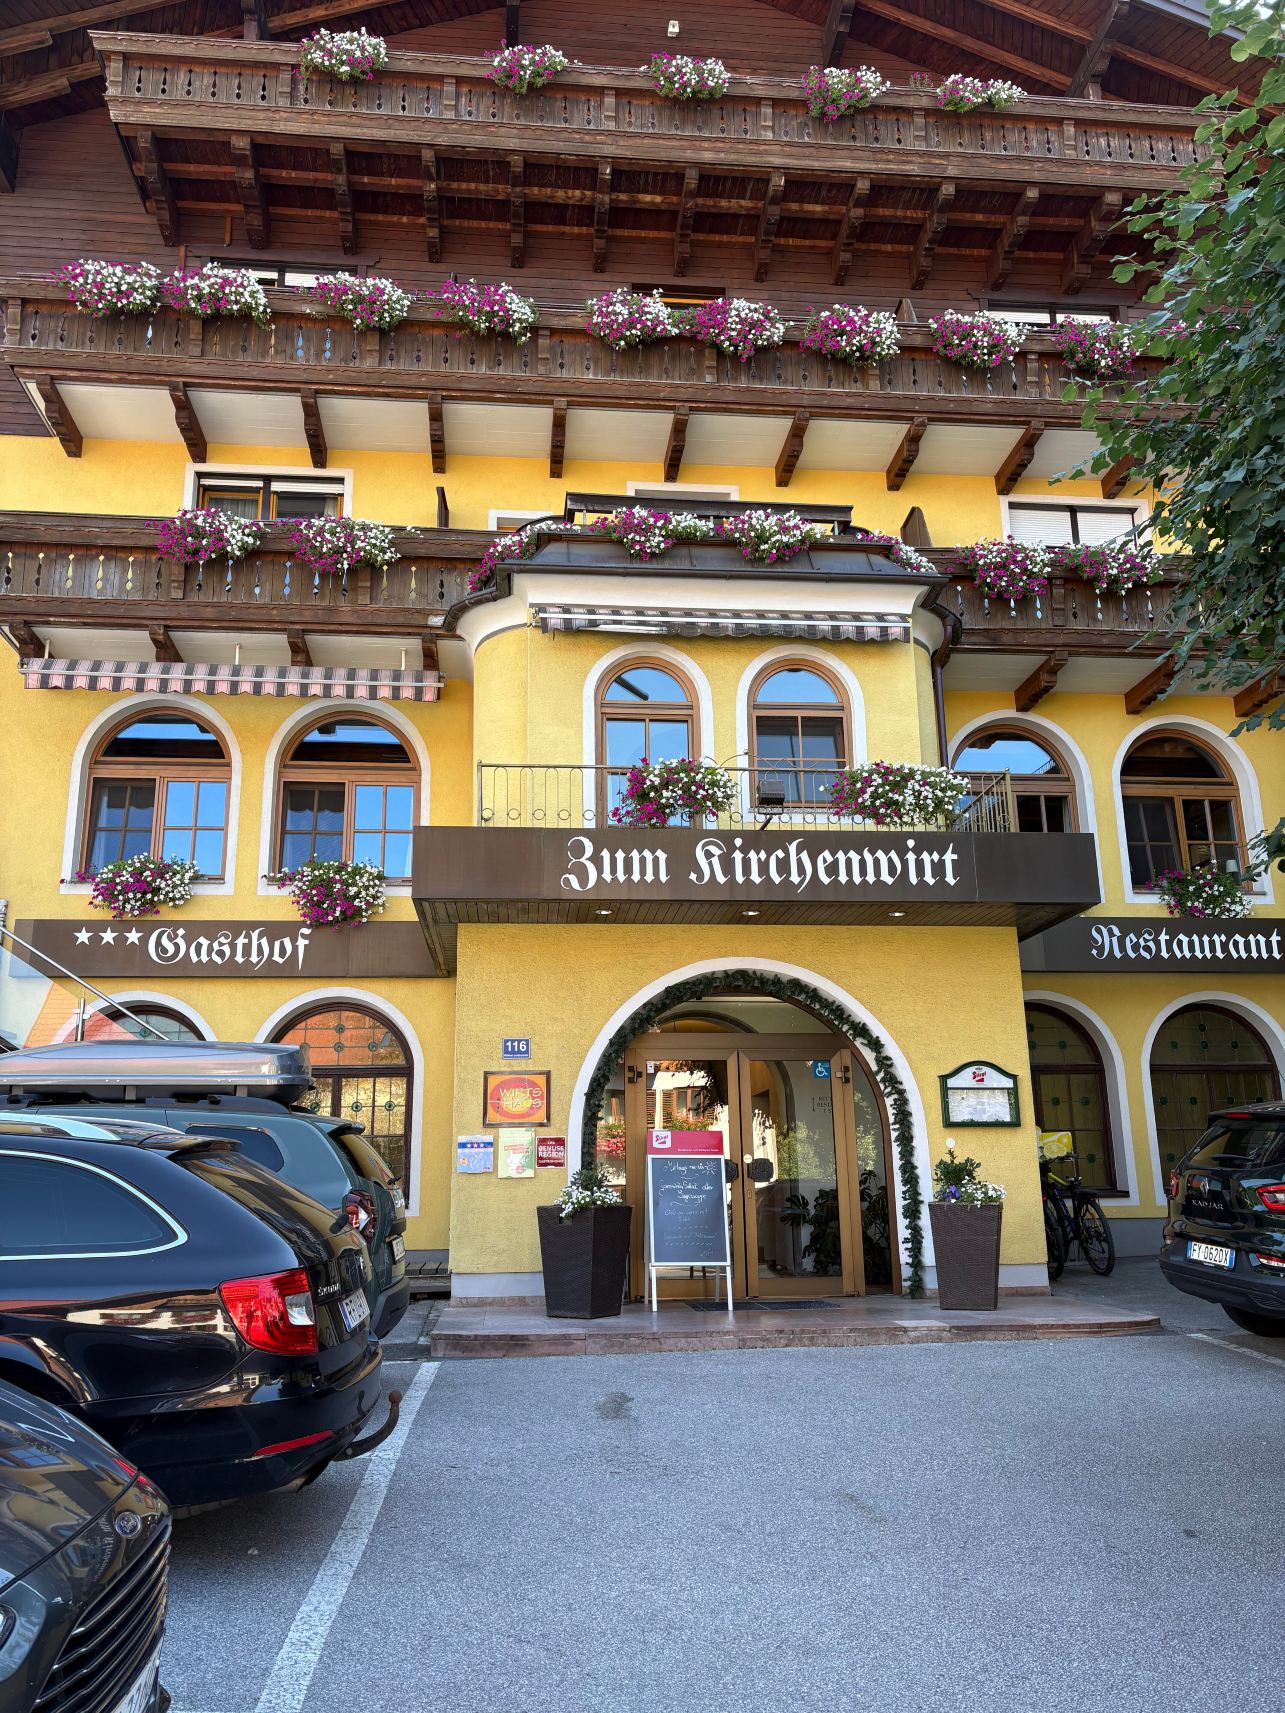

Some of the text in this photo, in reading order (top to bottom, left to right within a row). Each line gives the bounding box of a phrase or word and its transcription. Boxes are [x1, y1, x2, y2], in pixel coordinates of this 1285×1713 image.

[560, 835, 960, 893] Zum Kirchenwirt
[147, 926, 312, 971] Gasthof
[1090, 924, 1284, 961] Restaurant
[505, 1040, 527, 1052] 116
[499, 1087, 542, 1097] WIRTS
[503, 1097, 542, 1108] HAUS
[1192, 1199, 1224, 1210] KADJAR
